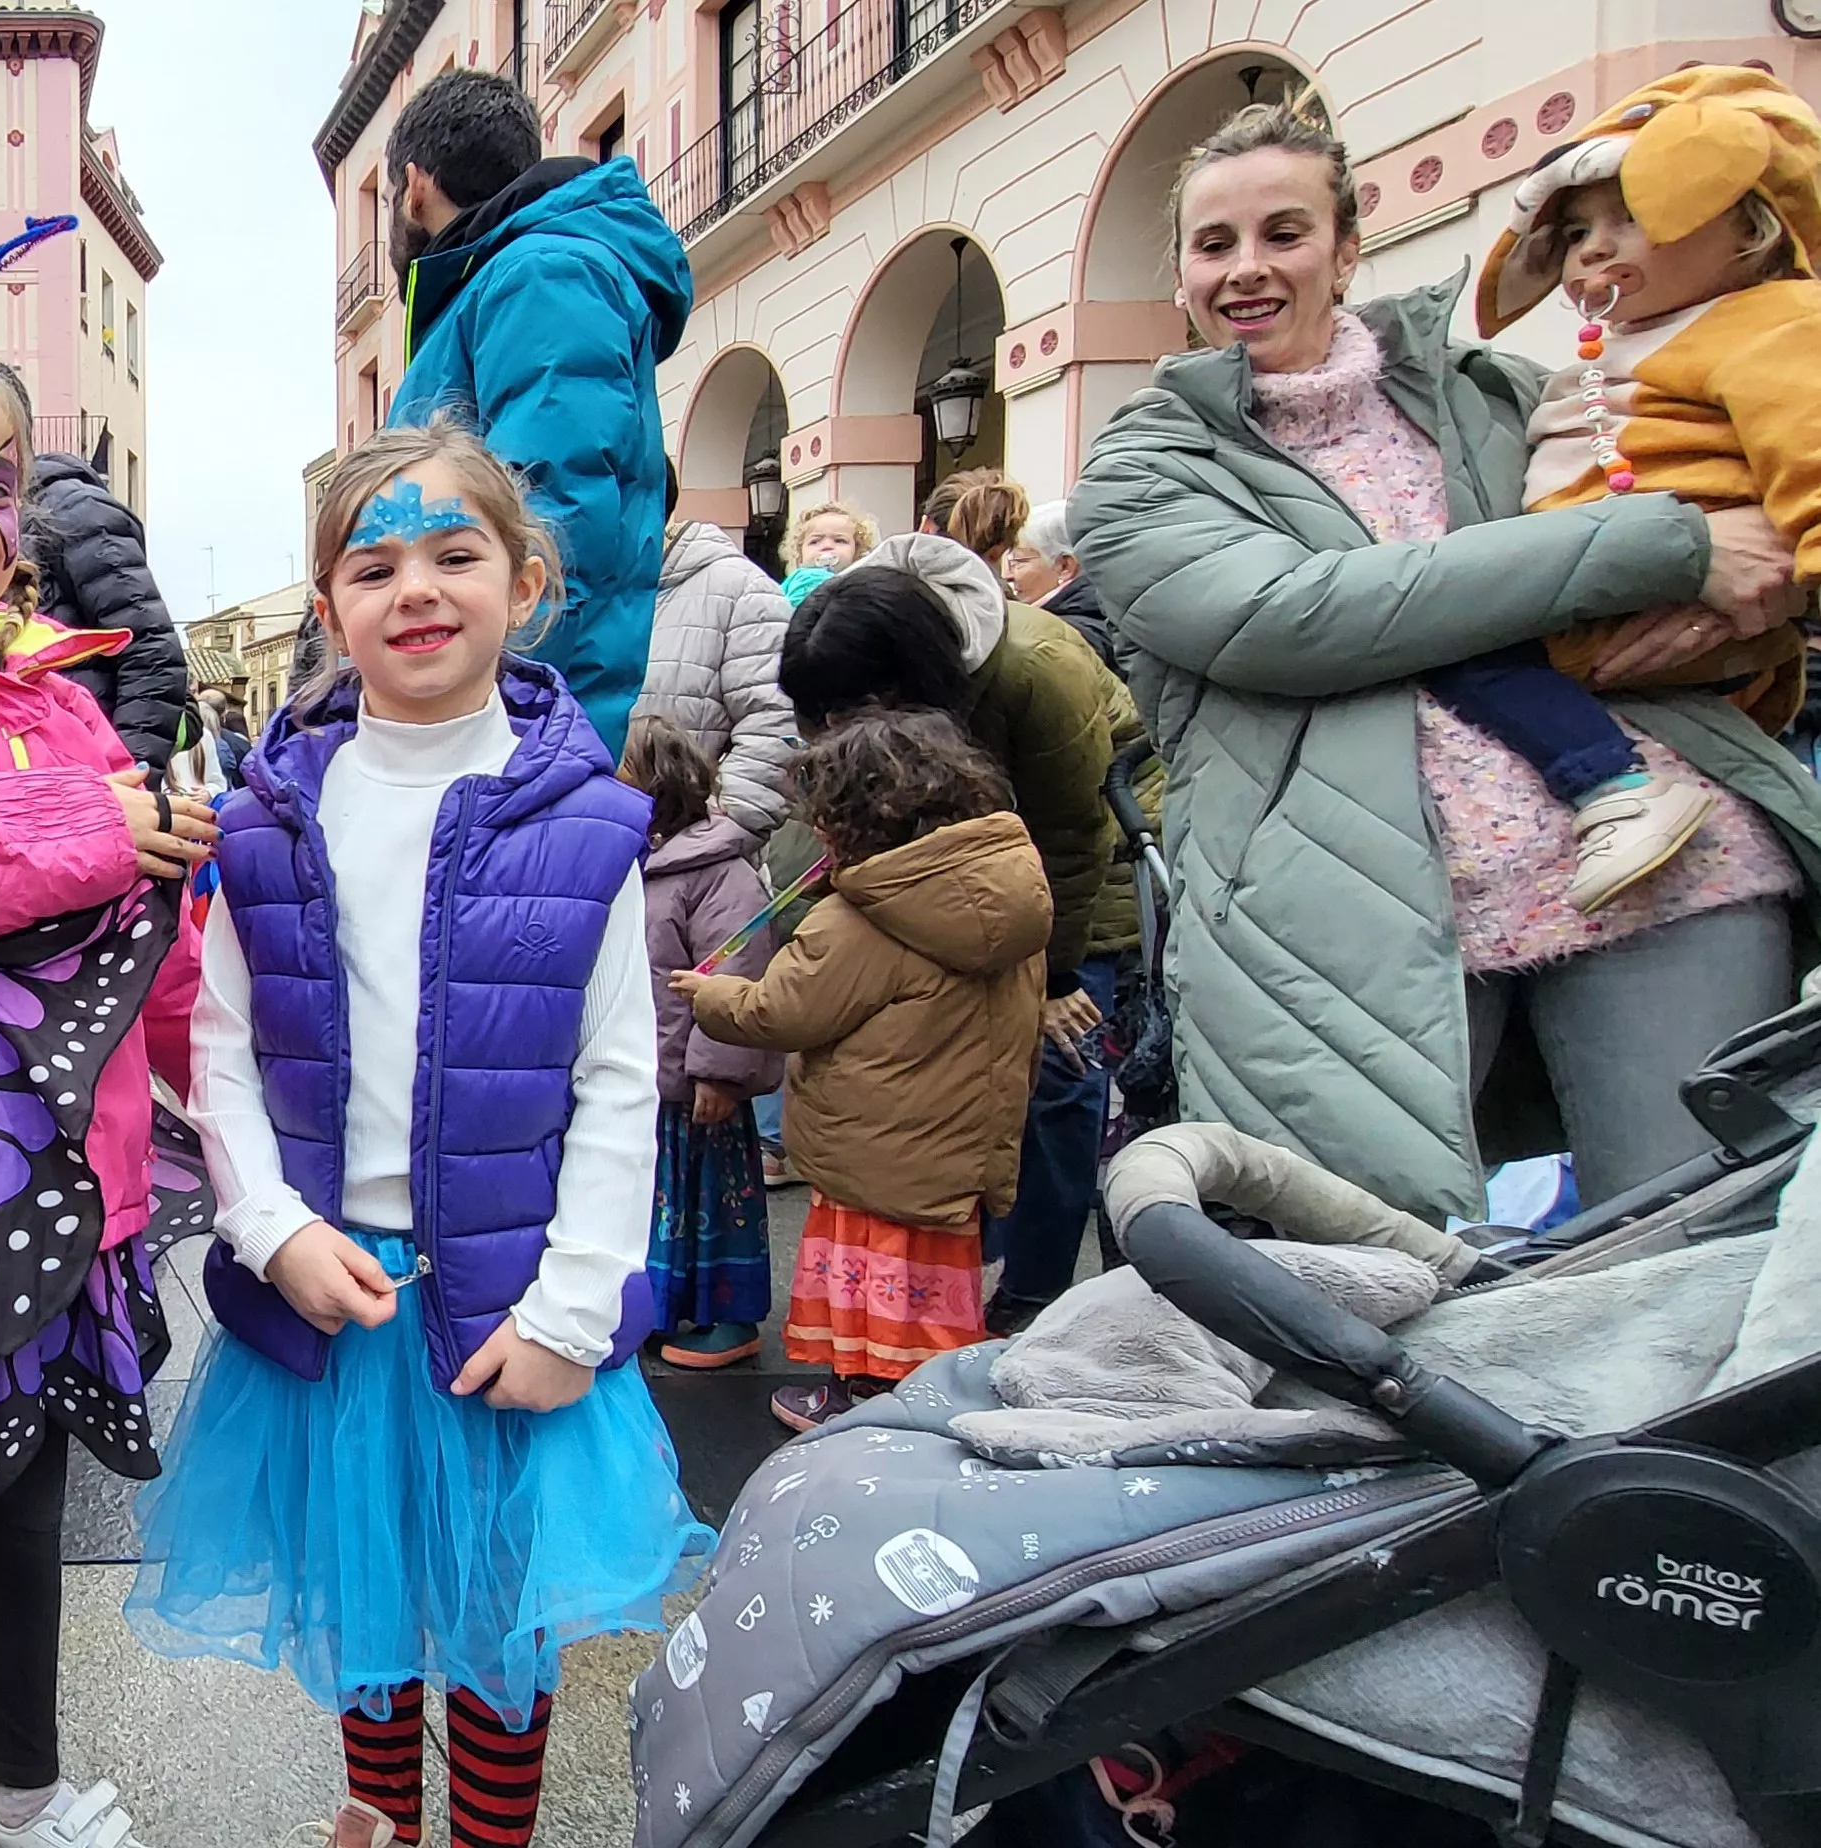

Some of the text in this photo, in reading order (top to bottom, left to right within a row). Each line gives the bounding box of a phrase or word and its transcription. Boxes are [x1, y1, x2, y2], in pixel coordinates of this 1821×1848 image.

[1021, 1533, 1039, 1560] BEAR
[1657, 1553, 1763, 1595] britax
[1597, 1573, 1763, 1631] römer
